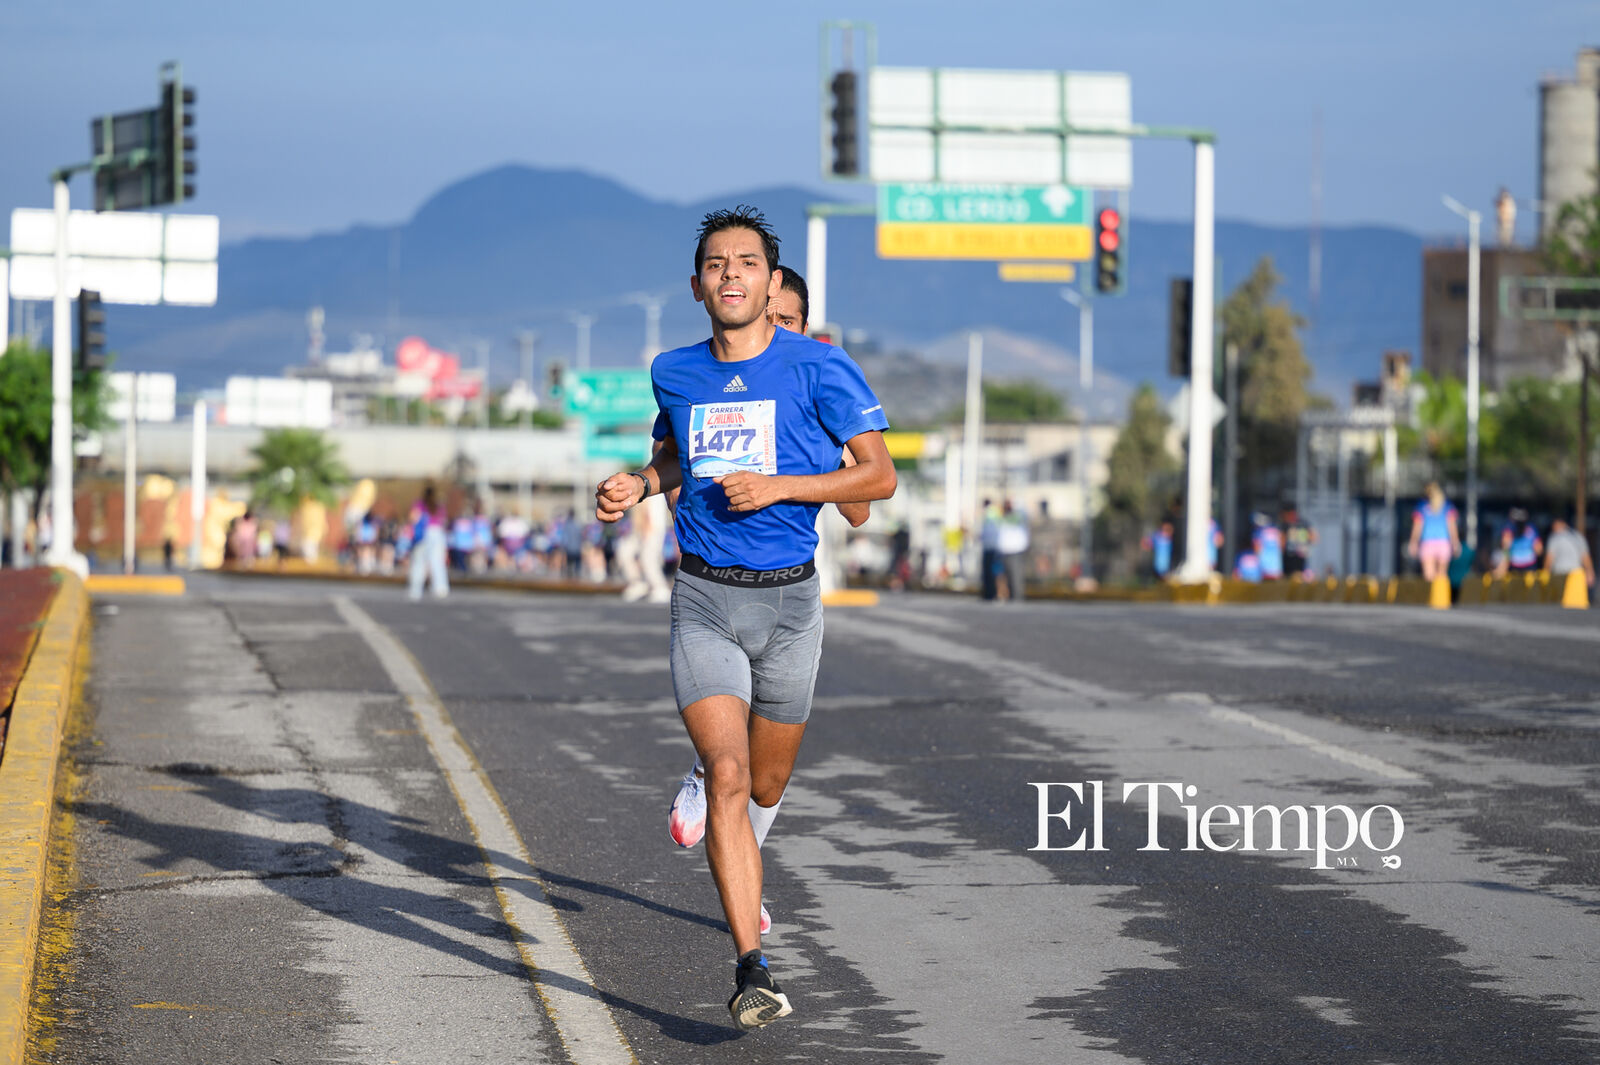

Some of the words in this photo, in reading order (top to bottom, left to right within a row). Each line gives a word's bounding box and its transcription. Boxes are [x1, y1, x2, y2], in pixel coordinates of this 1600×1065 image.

[709, 406, 744, 414] CARRERA
[694, 428, 756, 454] 1477
[702, 566, 758, 582] NIKE
[758, 565, 804, 582] PRO
